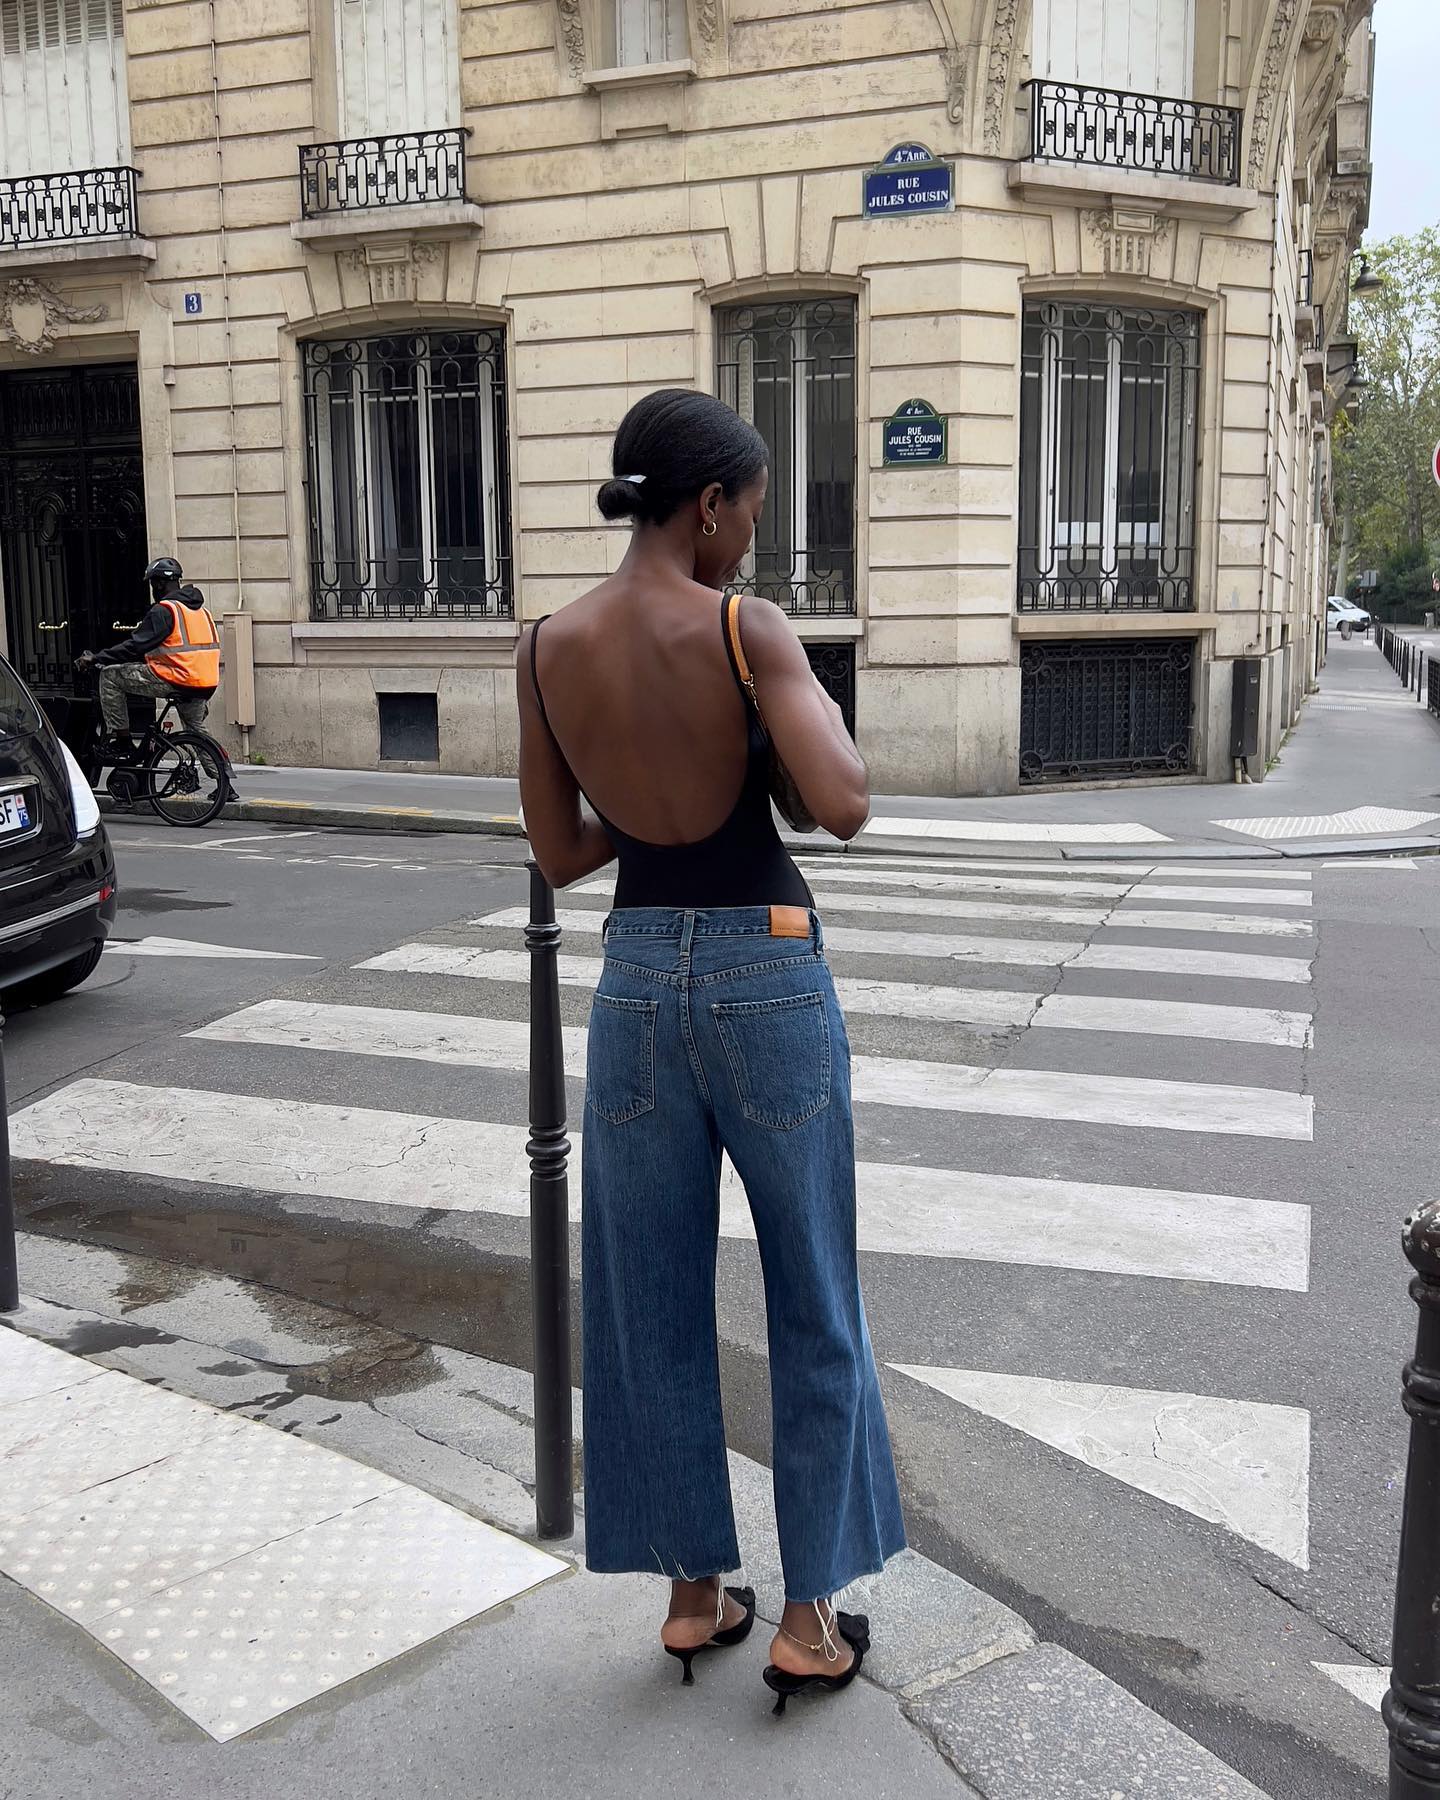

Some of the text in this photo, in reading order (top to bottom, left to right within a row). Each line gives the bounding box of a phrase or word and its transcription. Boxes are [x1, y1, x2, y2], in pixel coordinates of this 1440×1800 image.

[897, 177, 920, 190] RUE
[868, 190, 949, 208] JULES COUSIN
[189, 295, 198, 312] 3
[907, 426, 922, 436] RUE
[888, 434, 942, 445] JULES COUSIN
[18, 809, 29, 822] 75
